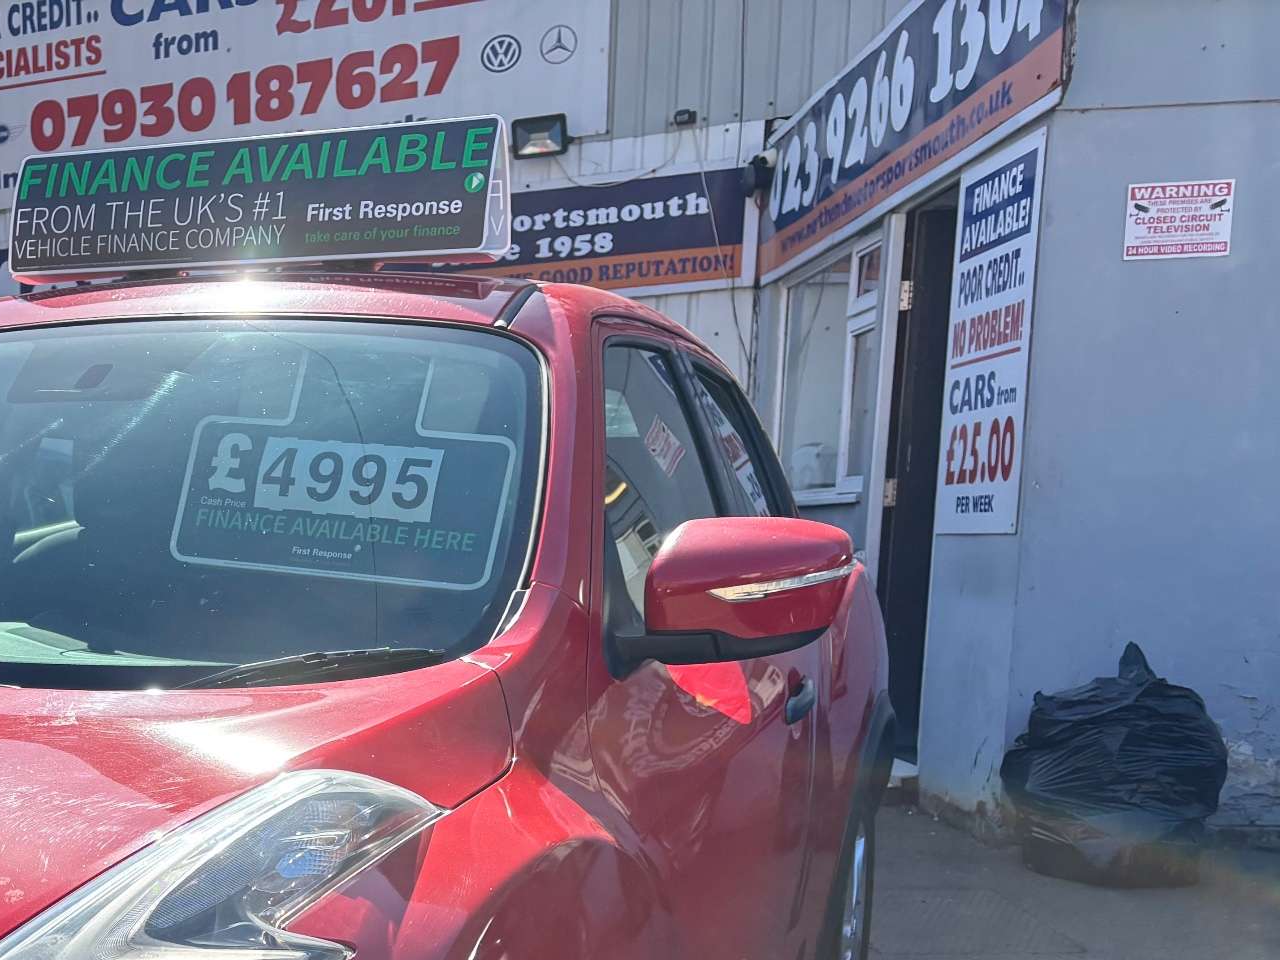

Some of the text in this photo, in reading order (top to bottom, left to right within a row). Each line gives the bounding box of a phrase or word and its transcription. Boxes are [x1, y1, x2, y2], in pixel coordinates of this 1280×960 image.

[152, 28, 218, 59] from
[30, 36, 460, 152] 07930 187627
[827, 30, 914, 184] 9266
[19, 127, 494, 200] FINANCE AVAILABLE
[973, 163, 1024, 215] FINANCE
[1134, 184, 1228, 200] WARNING
[15, 203, 95, 236] FROM
[105, 198, 164, 230] THE
[253, 191, 287, 220] #1
[306, 199, 462, 222] First Response
[511, 192, 709, 232] ortsmouth
[962, 197, 1030, 255] AVAILABLE!
[1135, 213, 1224, 225] CLOSED CIRCUIT
[14, 224, 286, 259] VEHICLE FINANCE COMPANY
[305, 225, 460, 244] take care of your finance
[535, 232, 614, 258] 1958
[1147, 223, 1210, 234] TELEVISION
[1127, 243, 1226, 254] 24 HOUR VIDEO RECORDING
[536, 253, 734, 284] GOOD REPUTATION!
[958, 264, 983, 308] POOR
[952, 299, 1024, 358] NO PROBLEM!
[949, 371, 1017, 415] CARS from
[945, 416, 1014, 486] £25.00
[200, 496, 223, 507] Cash
[956, 495, 994, 514] PER WEEK
[196, 509, 476, 551] FINANCE AVAILABLE HERE
[292, 546, 353, 559] First Response
